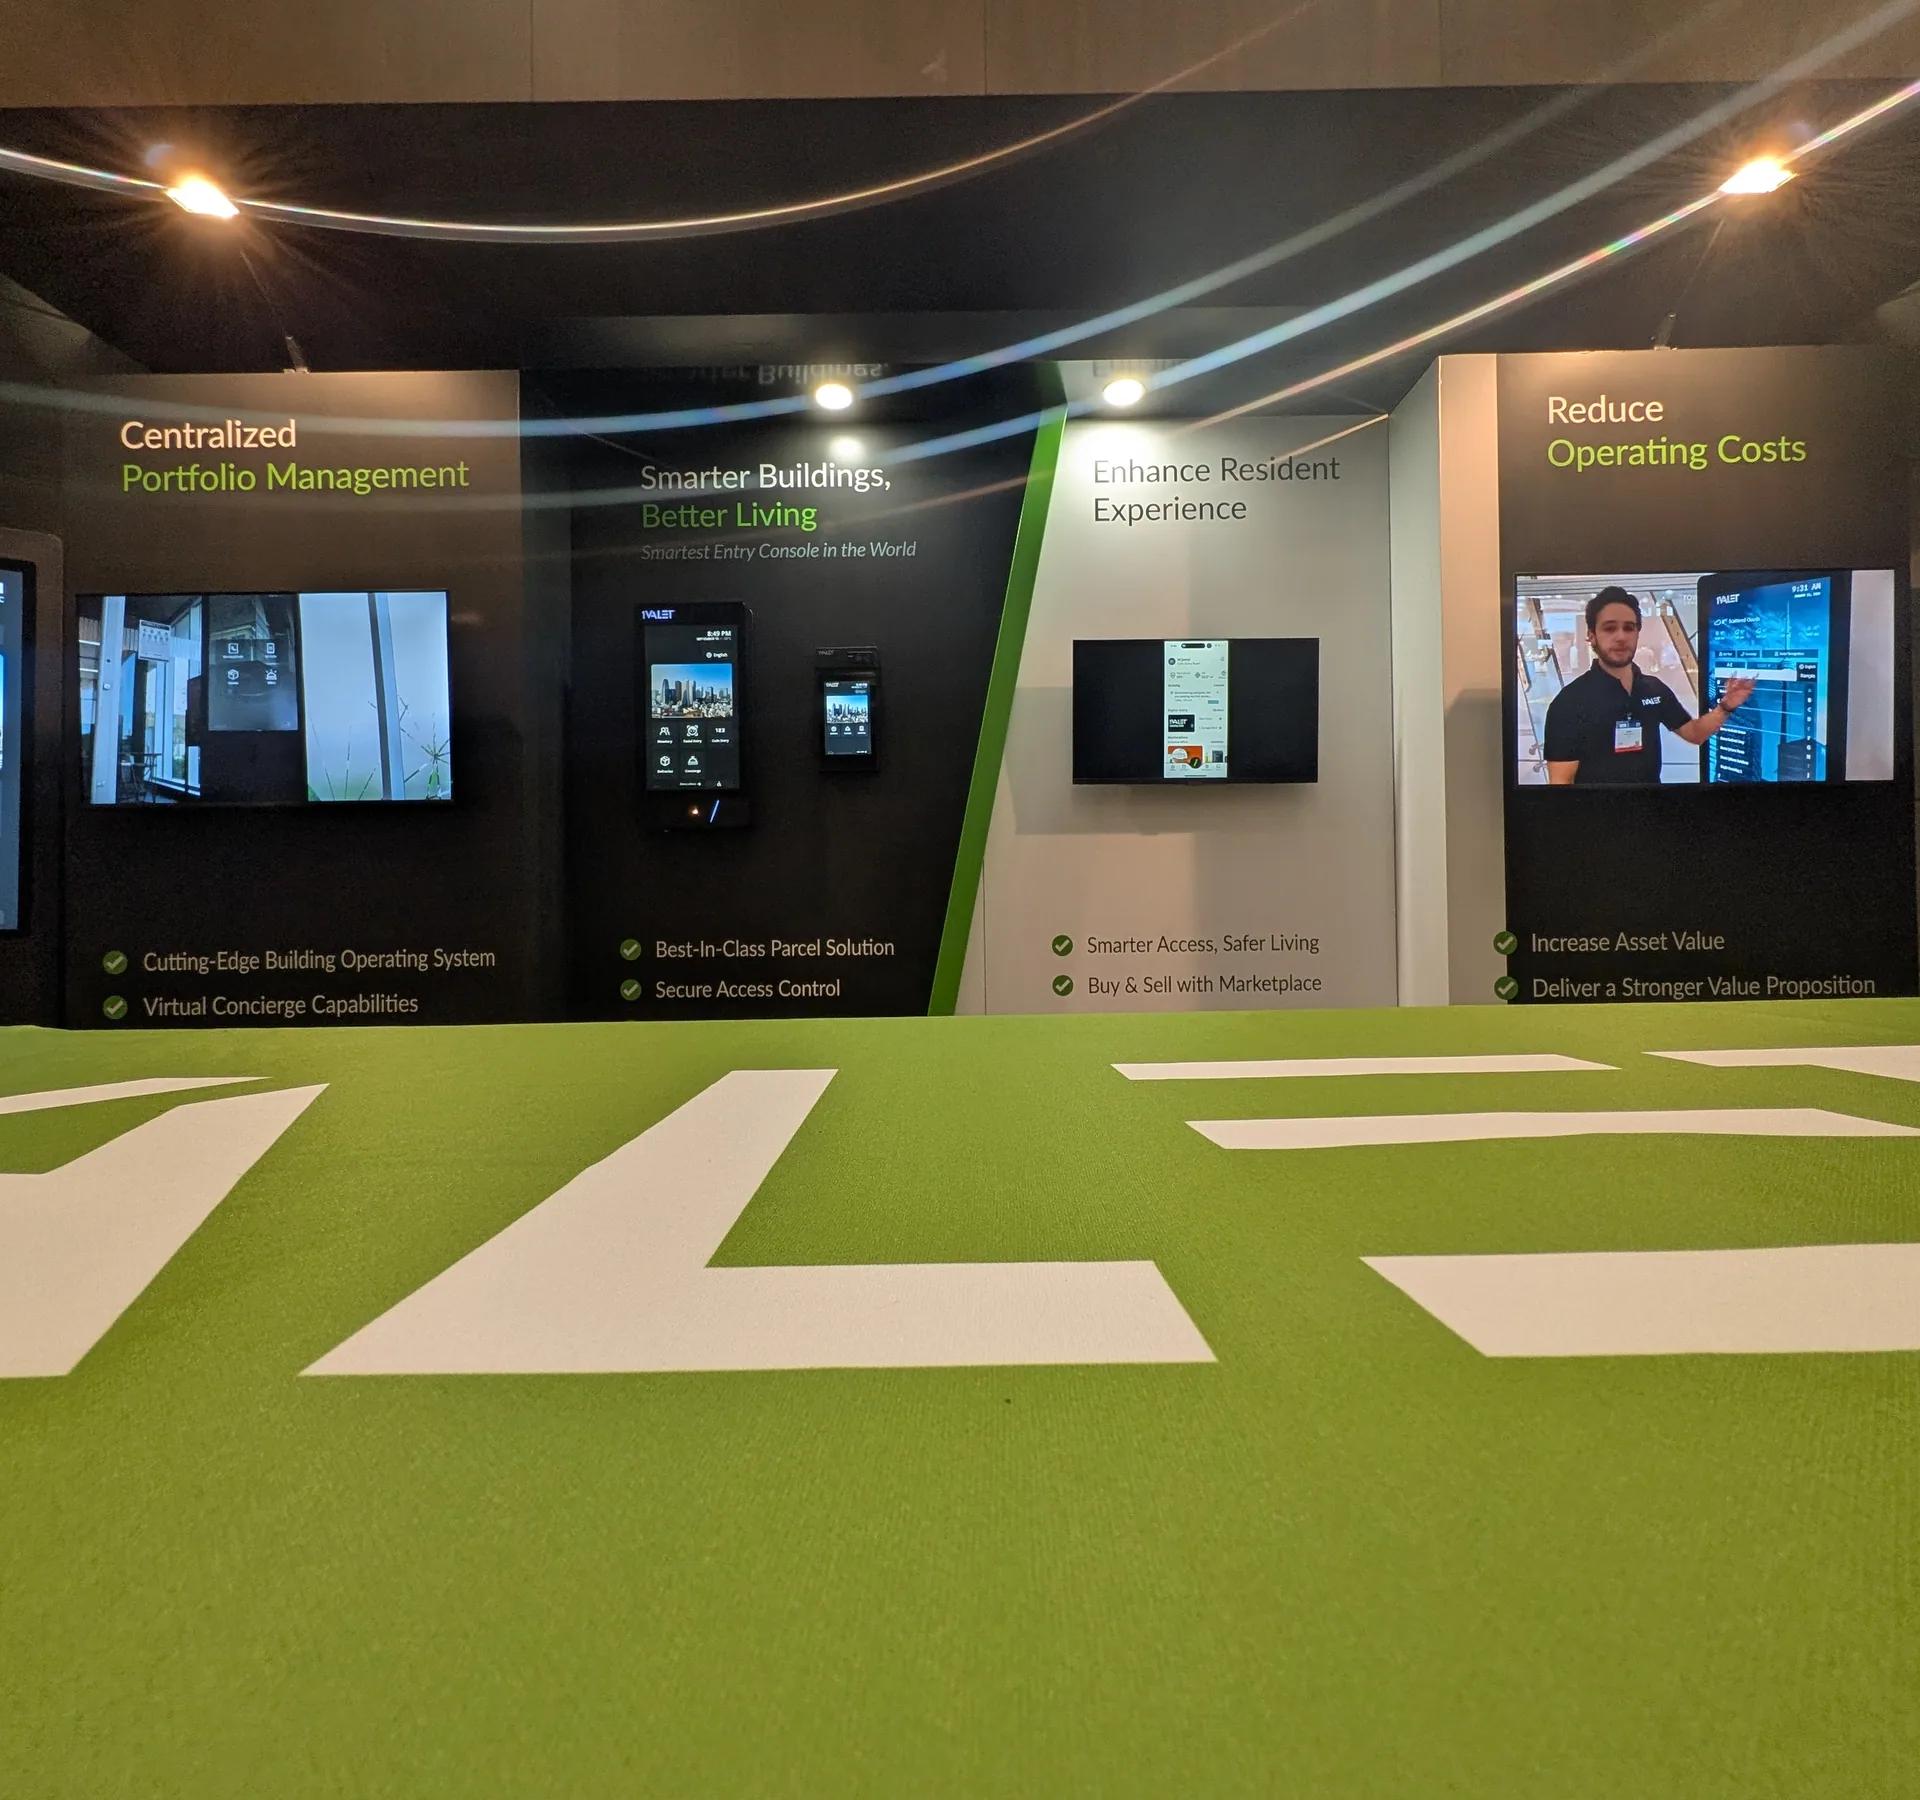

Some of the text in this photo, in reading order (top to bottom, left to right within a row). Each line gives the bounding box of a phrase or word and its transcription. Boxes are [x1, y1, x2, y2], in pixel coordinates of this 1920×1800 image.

[1549, 395, 1664, 424] Reduce
[121, 418, 296, 449] Centralized
[1548, 435, 1805, 472] Operating Costs
[124, 461, 469, 494] Portfolio Management
[642, 462, 890, 492] Smarter Buildings,
[1095, 456, 1341, 482] Enhance Resident
[642, 501, 817, 531] Better Living
[1094, 496, 1246, 526] Experience
[640, 541, 916, 561] Smartest Entry Console in the World
[657, 938, 894, 957] Best-In-Class Parcel Solution
[1088, 934, 1319, 955] Smarter Access, Safer Living
[1532, 931, 1724, 952] Increase Asset Value
[144, 948, 495, 974] Cutting-Edge Building Operating System
[656, 979, 840, 998] Secure Access Control
[1089, 974, 1321, 997] Buy & Sell with Marketplace
[1533, 975, 1875, 1000] Deliver a Stronger Value Proposition
[143, 994, 418, 1018] Virtual Concierge Capabilities
